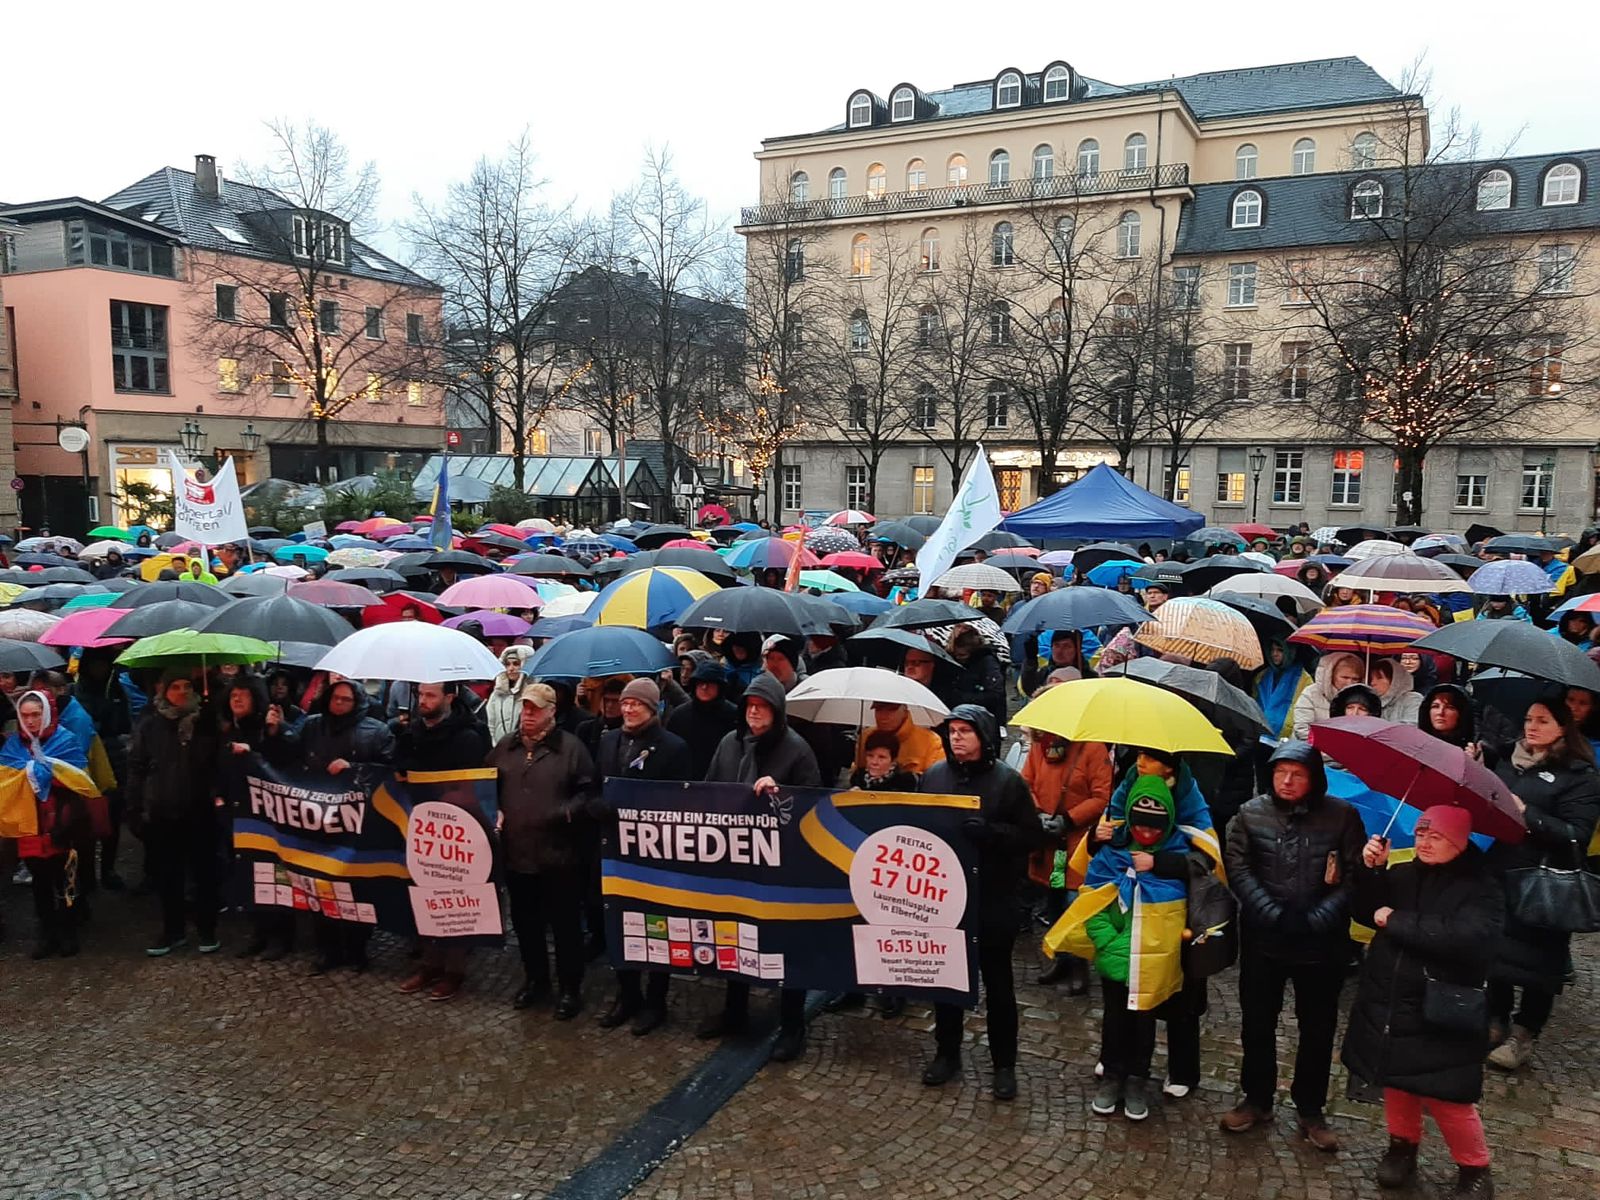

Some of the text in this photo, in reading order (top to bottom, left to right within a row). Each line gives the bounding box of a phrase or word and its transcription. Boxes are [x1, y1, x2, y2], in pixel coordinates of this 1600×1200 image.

[290, 787, 309, 799] EIN
[343, 790, 364, 802] FÜR
[249, 785, 365, 835] FRIEDEN
[427, 809, 457, 821] FREITAG
[617, 808, 778, 828] WIR SETZEN EIN ZEICHEN FÜR
[414, 818, 472, 844] 24.02.
[413, 838, 475, 864] 17 Uhr
[618, 821, 781, 867] FRIEDEN
[895, 835, 933, 851] FREITAG
[875, 844, 947, 879] 24.02.
[870, 868, 949, 902] 17 Uhr
[425, 896, 481, 911] 16.15 Uhr
[873, 890, 940, 915] Laurentiusplatz
[880, 903, 929, 923] in Elberfeld
[877, 939, 947, 955] 16.15 Uhr
